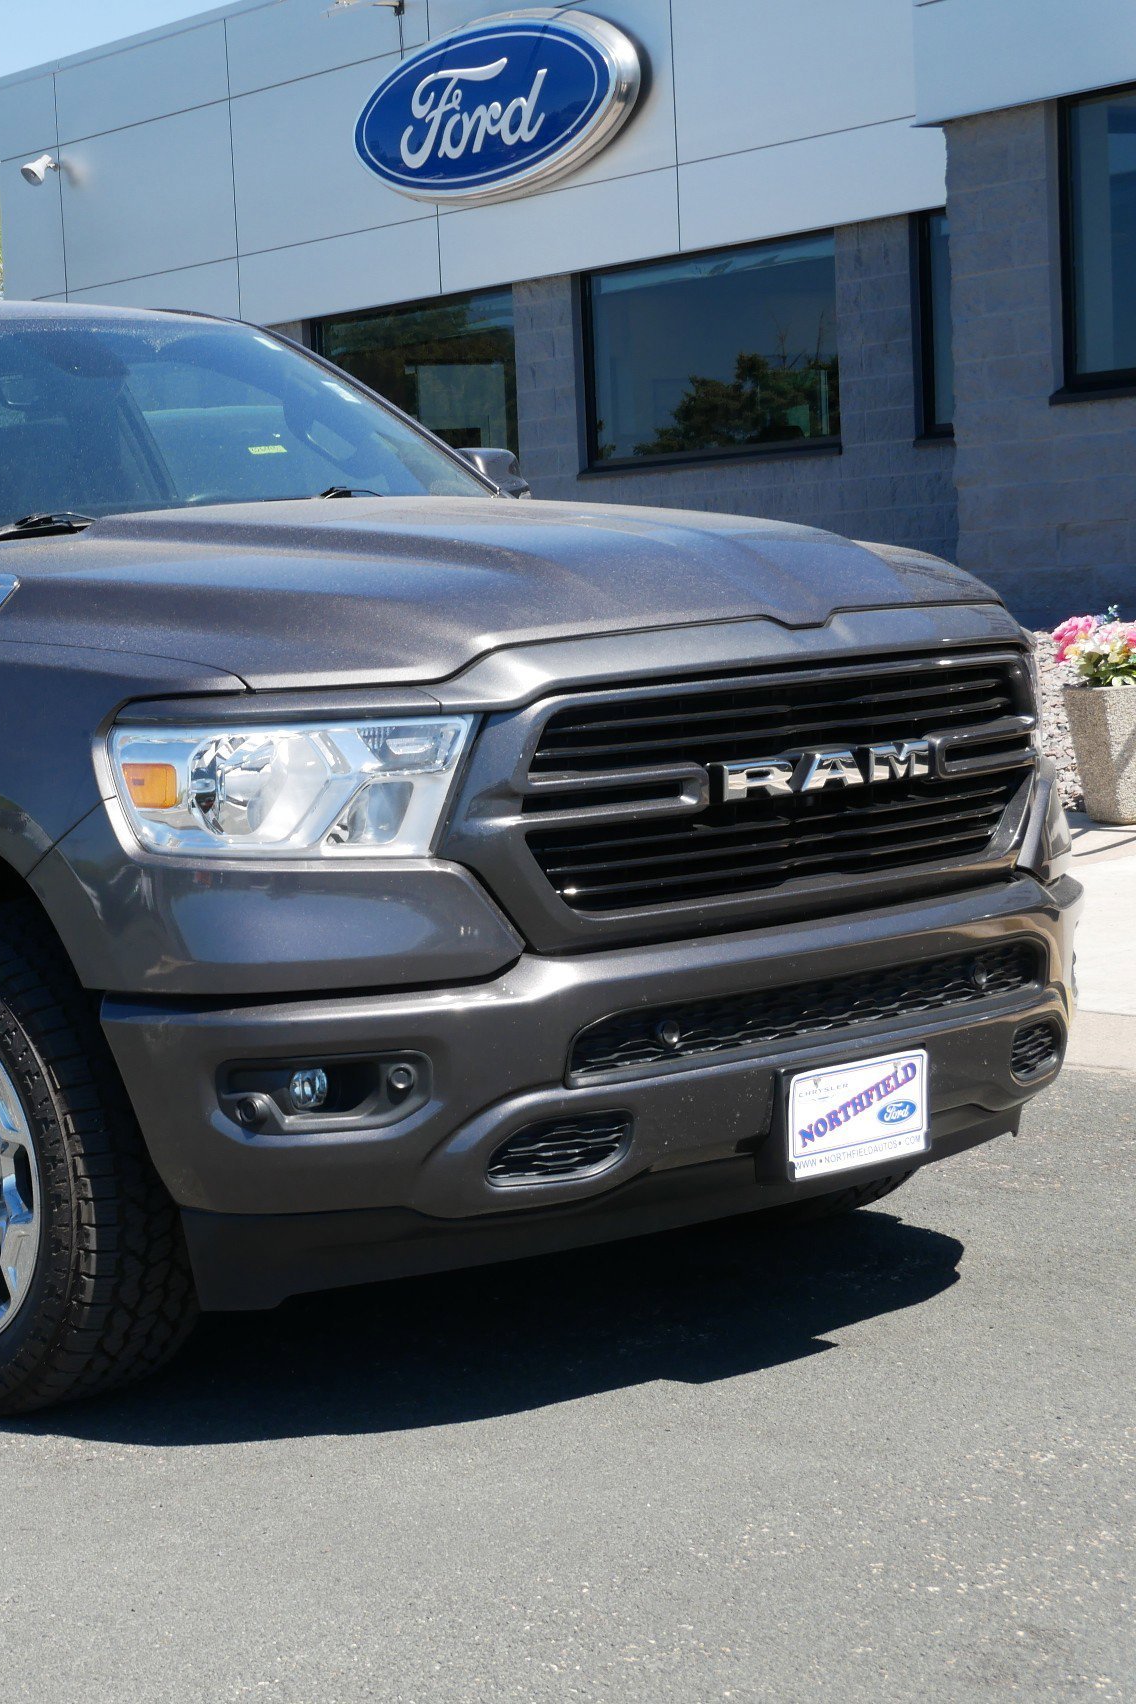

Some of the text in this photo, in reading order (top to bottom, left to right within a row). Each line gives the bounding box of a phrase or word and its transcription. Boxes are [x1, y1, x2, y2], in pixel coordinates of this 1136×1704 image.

[400, 57, 548, 169] Ford
[721, 740, 929, 801] RAM
[798, 1083, 849, 1098] CHRYSLER
[798, 1062, 917, 1148] NORTHFIELD
[884, 1103, 910, 1121] Ford
